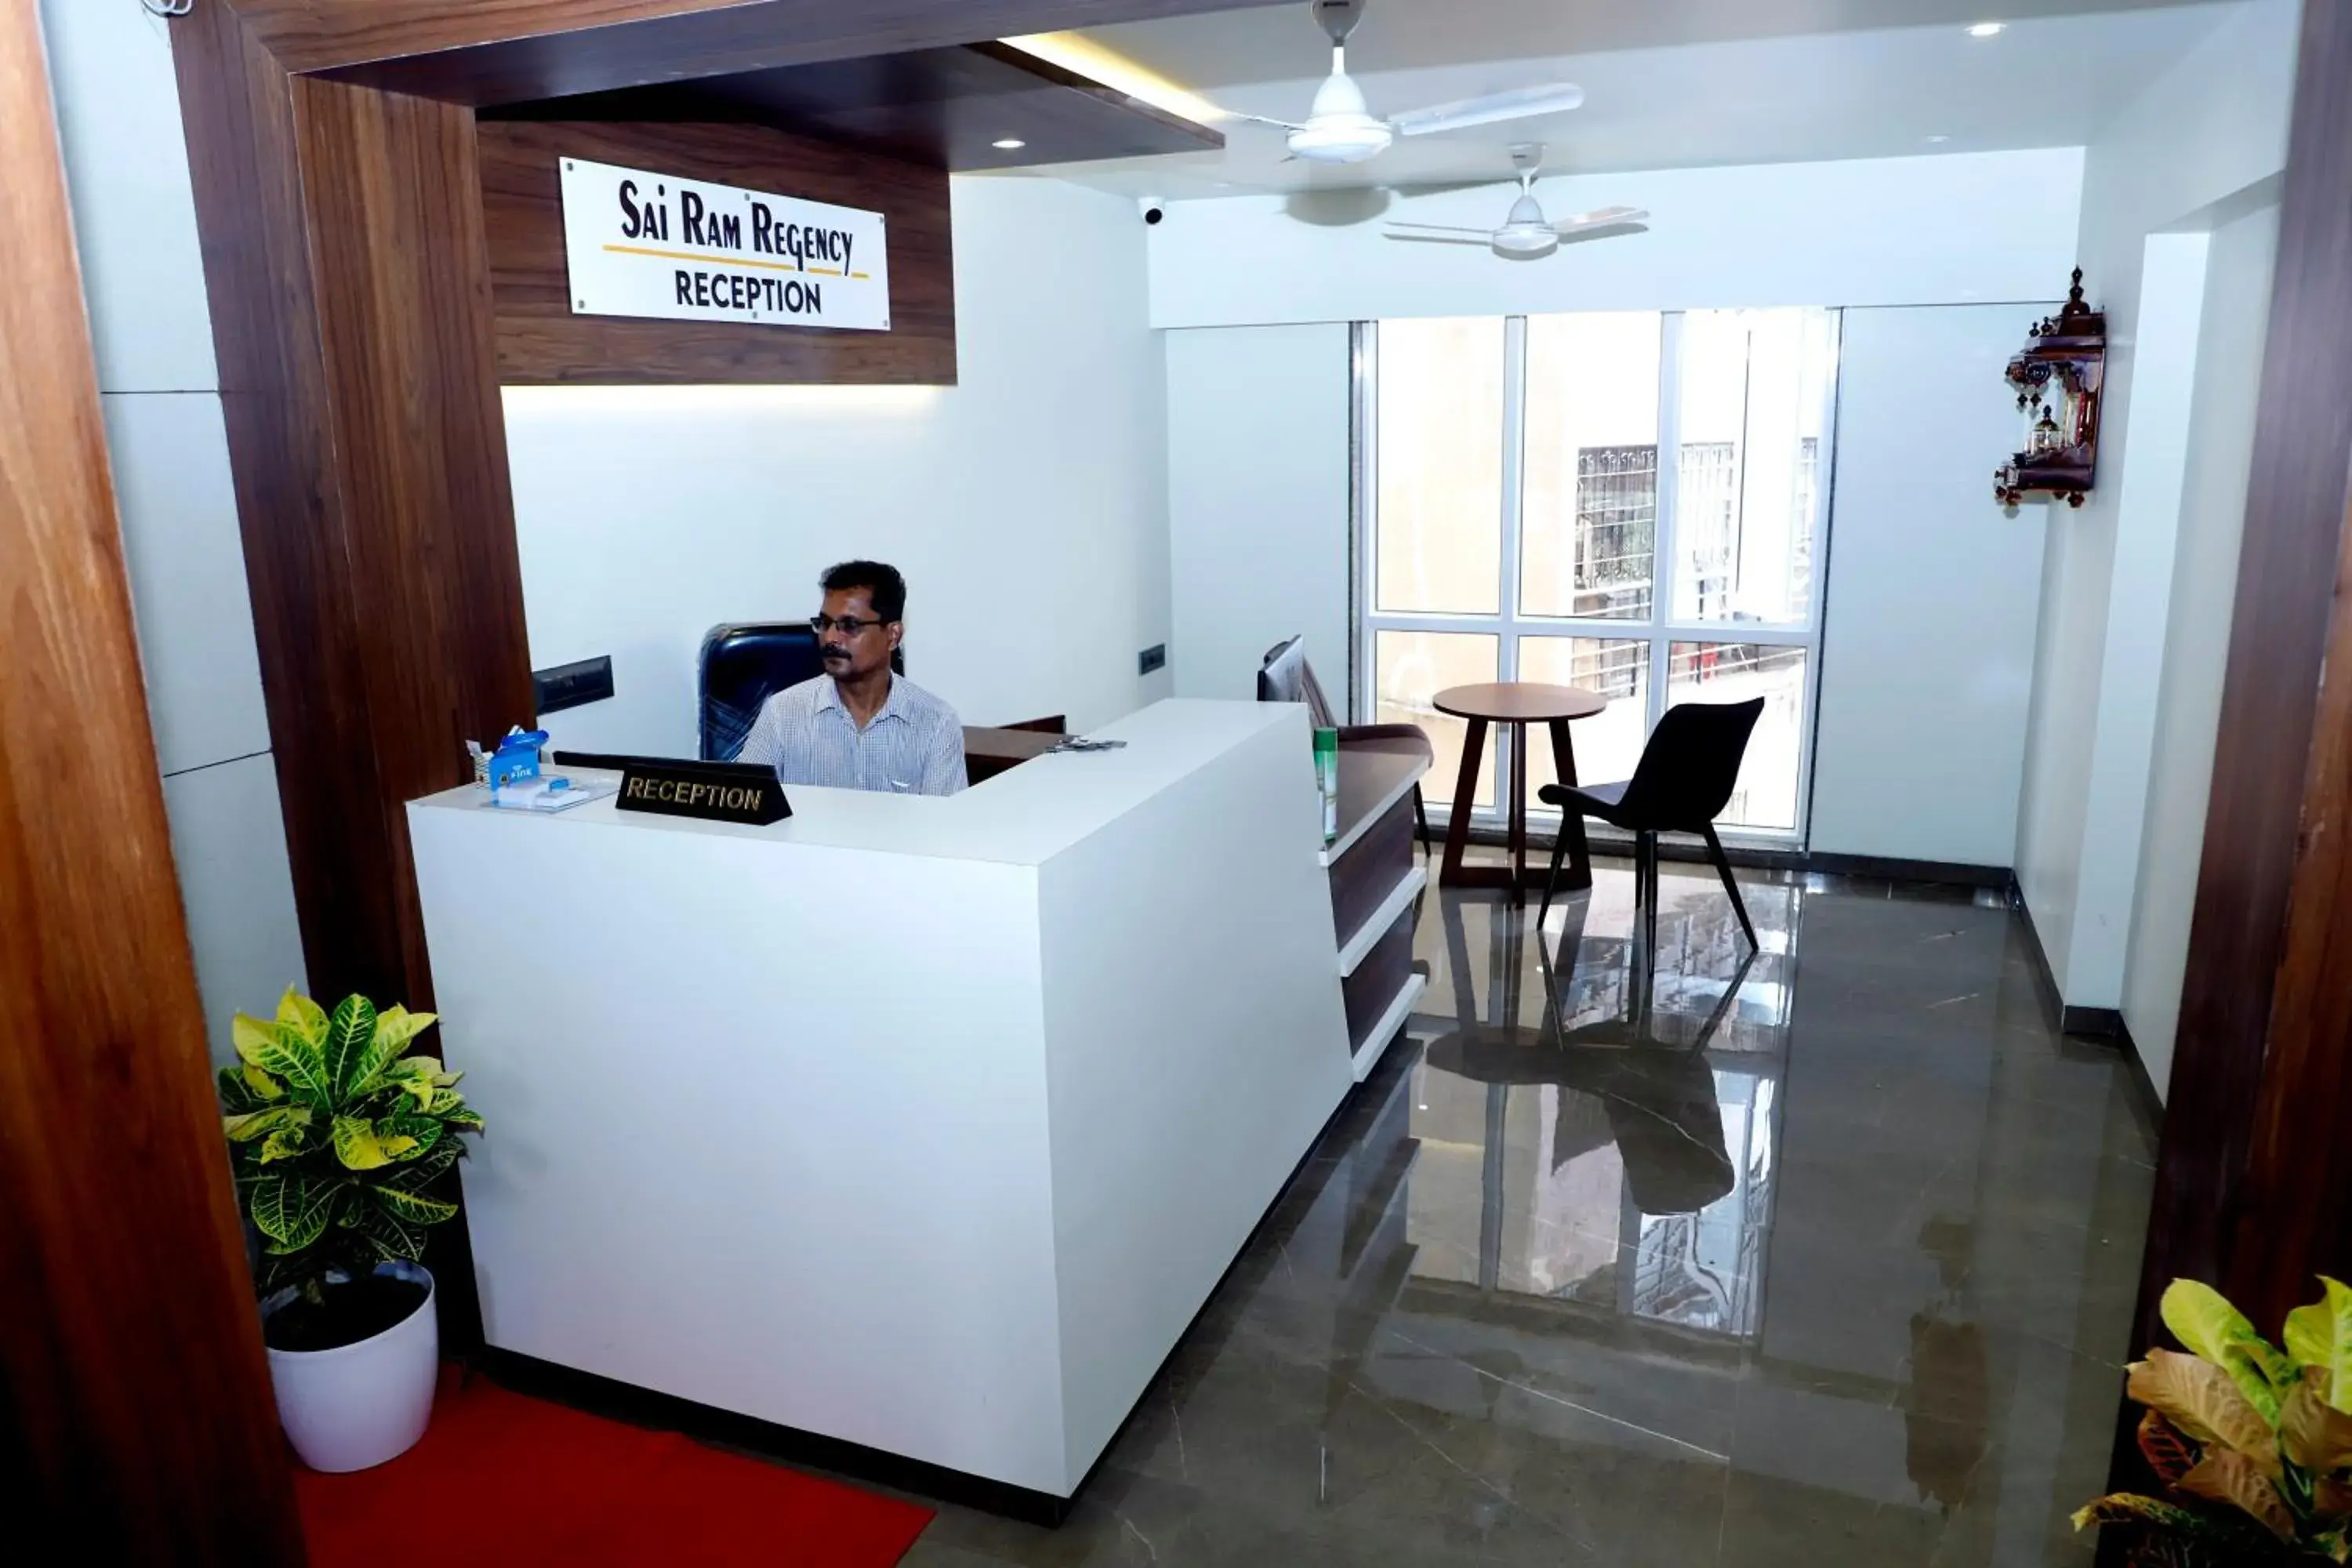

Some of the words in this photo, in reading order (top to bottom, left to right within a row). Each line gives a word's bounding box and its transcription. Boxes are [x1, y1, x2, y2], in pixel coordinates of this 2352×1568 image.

[680, 189, 742, 250] RAM
[674, 269, 822, 314] RECEPTION
[626, 776, 763, 811] RECEPTION
